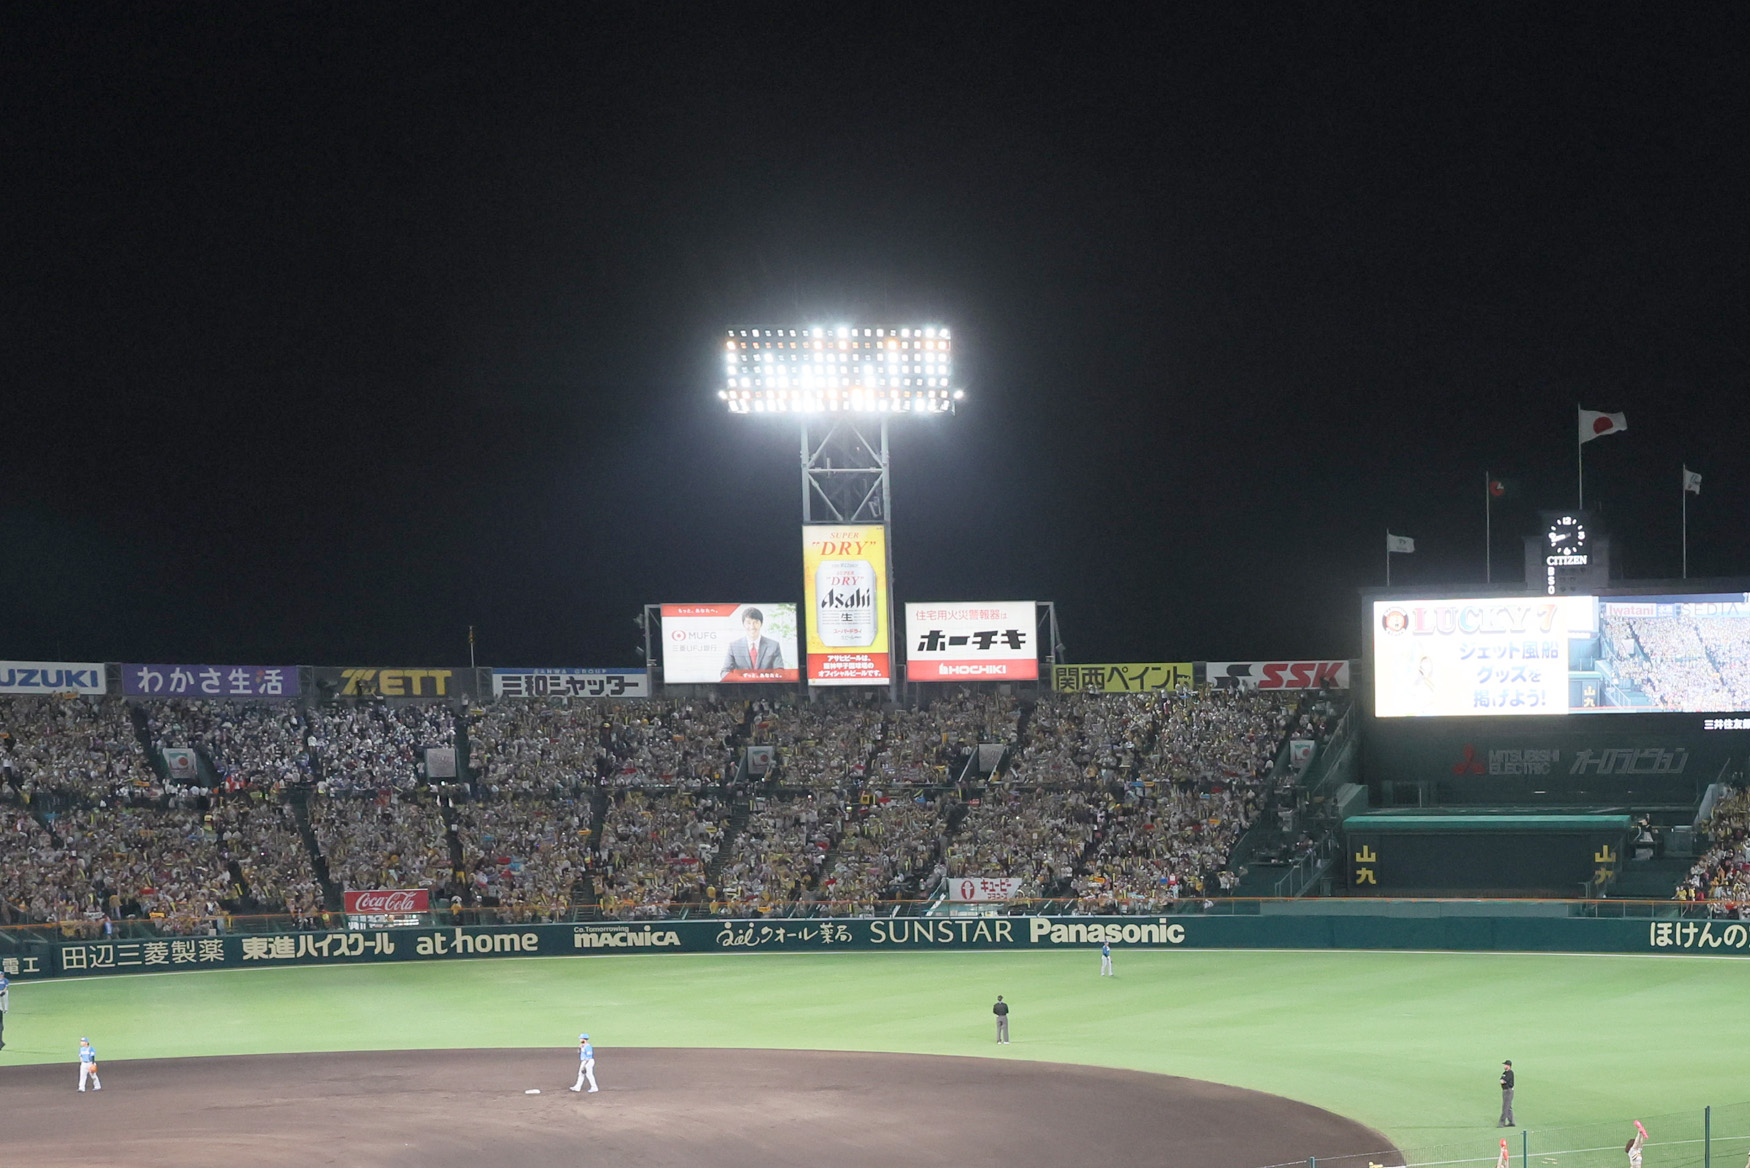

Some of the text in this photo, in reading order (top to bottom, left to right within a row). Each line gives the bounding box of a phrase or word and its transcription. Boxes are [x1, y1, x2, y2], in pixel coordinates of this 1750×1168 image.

[1546, 555, 1588, 566] CITIZEN
[821, 588, 871, 609] Asahi
[841, 613, 853, 622] 生
[916, 609, 1008, 621] 住宅用火災警報器は
[1412, 605, 1531, 636] LUCKY
[1538, 603, 1560, 632] 7
[1609, 605, 1655, 616] Iwatani
[688, 631, 717, 640] MUFG
[917, 629, 1027, 651] ホーチキ
[1459, 641, 1560, 660] ジェット風船
[137, 666, 284, 695] わかさ生活
[948, 665, 1007, 674] HOCHIKI
[1055, 666, 1191, 692] 関西ペイント
[1258, 663, 1344, 689] SSK
[1477, 664, 1541, 684] グッズを
[341, 669, 452, 696] ZETT
[502, 675, 640, 697] 三和シャッター
[1489, 749, 1560, 762] MITSUBISHI
[1489, 762, 1551, 775] ELECTRIC
[1355, 845, 1377, 885] 山九
[981, 879, 1012, 893] キューピー
[355, 891, 415, 913] Coca-Cola
[416, 927, 539, 955] at home
[870, 920, 1014, 944] SUNSTAR
[1029, 918, 1186, 944] Panasonic
[62, 939, 225, 970] 田辺三菱製薬
[242, 933, 395, 961] 東進ハイスクール
